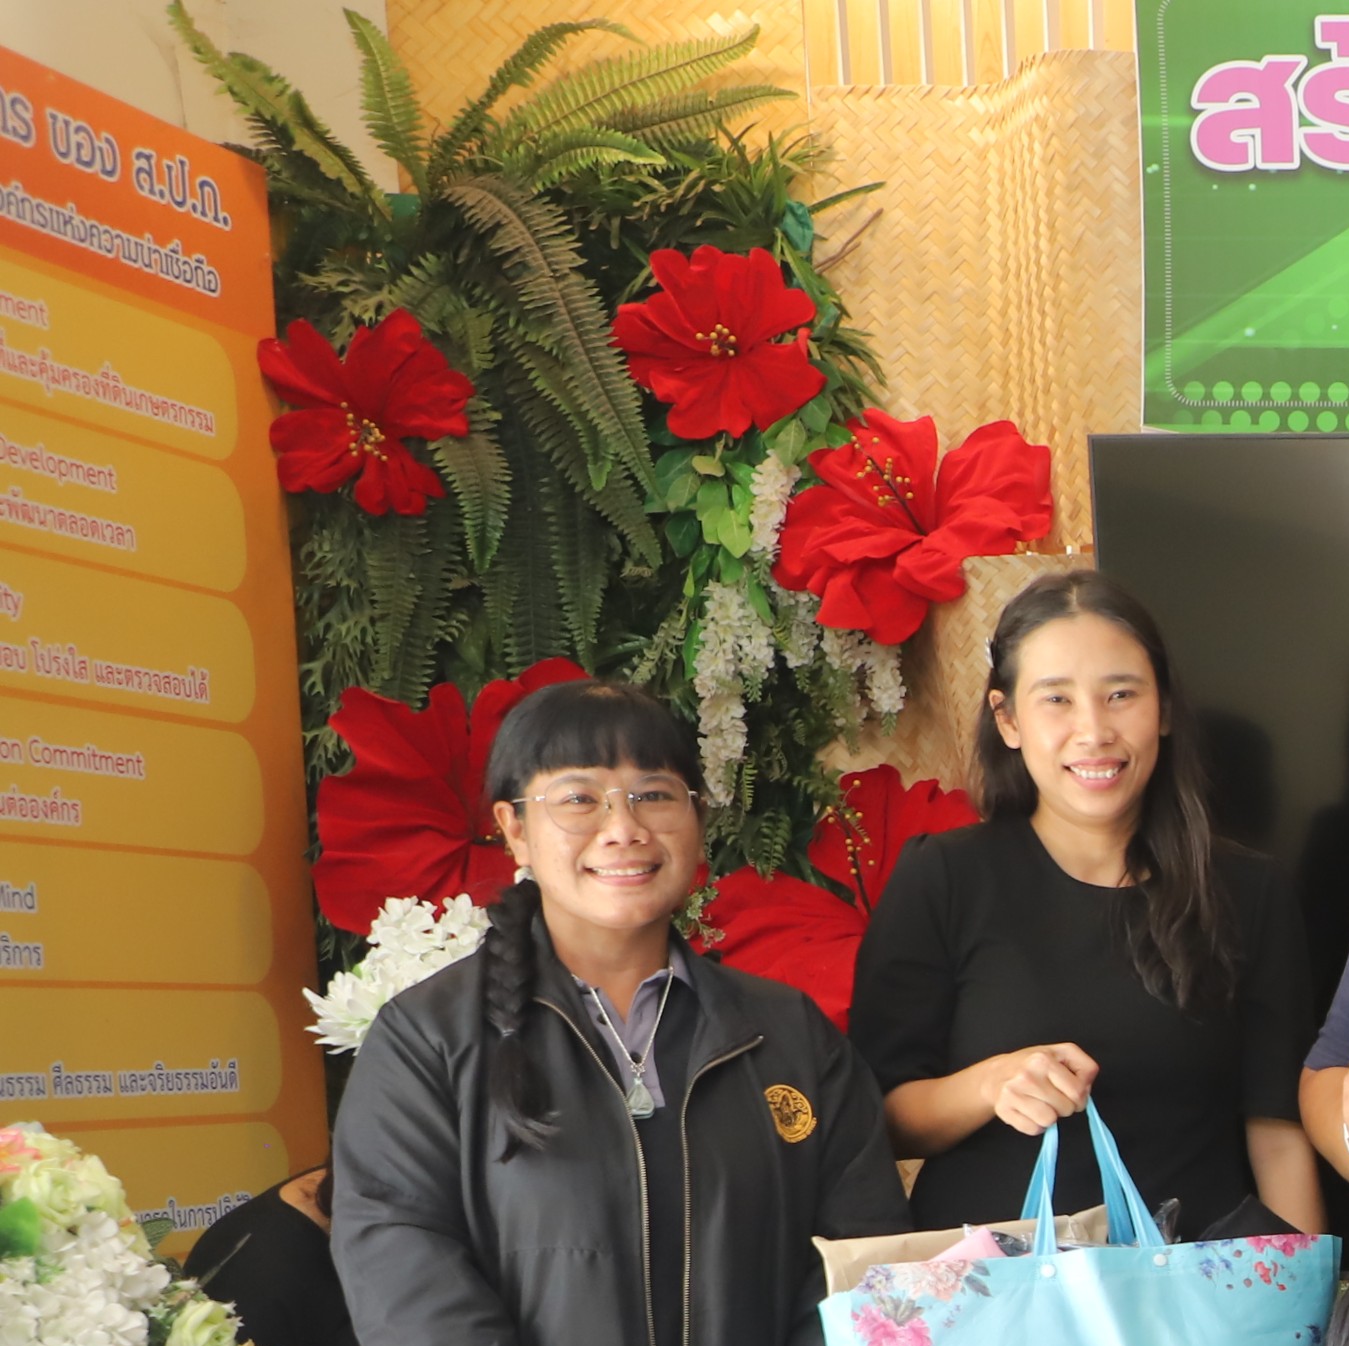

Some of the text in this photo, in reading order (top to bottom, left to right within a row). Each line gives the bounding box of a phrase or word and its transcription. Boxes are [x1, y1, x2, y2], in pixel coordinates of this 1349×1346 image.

[49, 111, 118, 179] ของ
[134, 150, 230, 228] ส.ป.ก.
[31, 639, 88, 680] โปร่งใส
[95, 663, 208, 701] และตรวจสอบได้
[29, 738, 144, 777] Commitment
[0, 934, 42, 966] ริการ
[53, 1063, 112, 1097] ศีลธรรม
